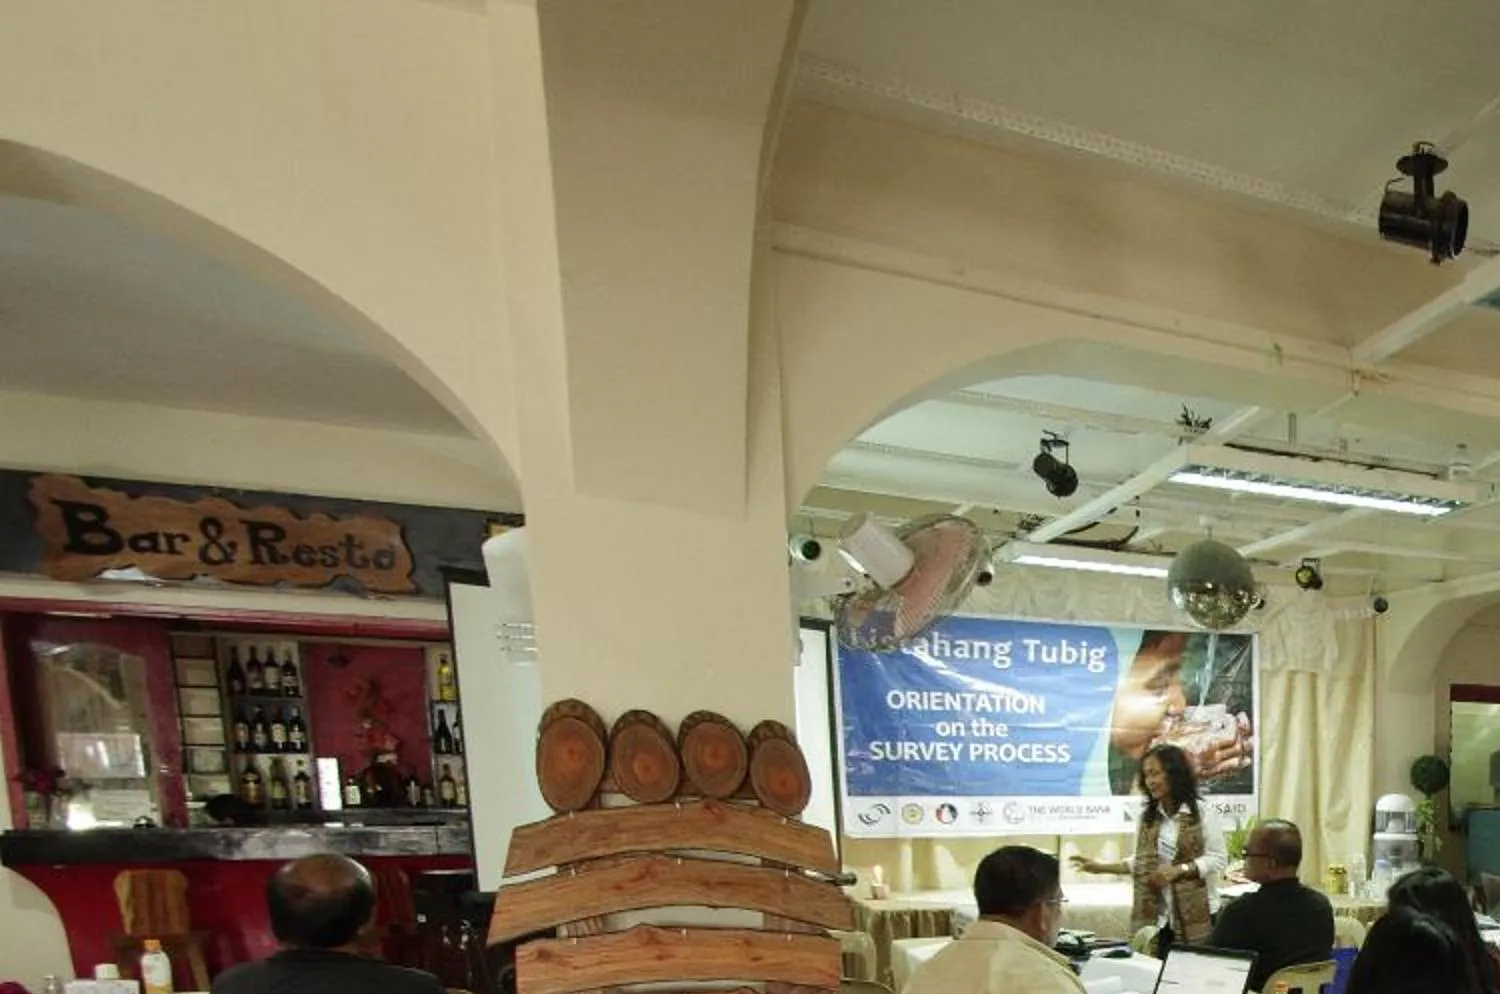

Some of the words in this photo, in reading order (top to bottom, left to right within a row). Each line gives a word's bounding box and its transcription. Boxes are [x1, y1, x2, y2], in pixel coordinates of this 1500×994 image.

[52, 499, 191, 556] Bar
[241, 519, 397, 571] Resto
[1023, 639, 1107, 672] Tubig
[886, 689, 1046, 714] ORIENTATION
[935, 721, 965, 737] on
[971, 717, 1009, 737] the
[869, 741, 963, 761] SURVEY
[969, 743, 1071, 763] PROCESS
[1211, 803, 1247, 814] SAID
